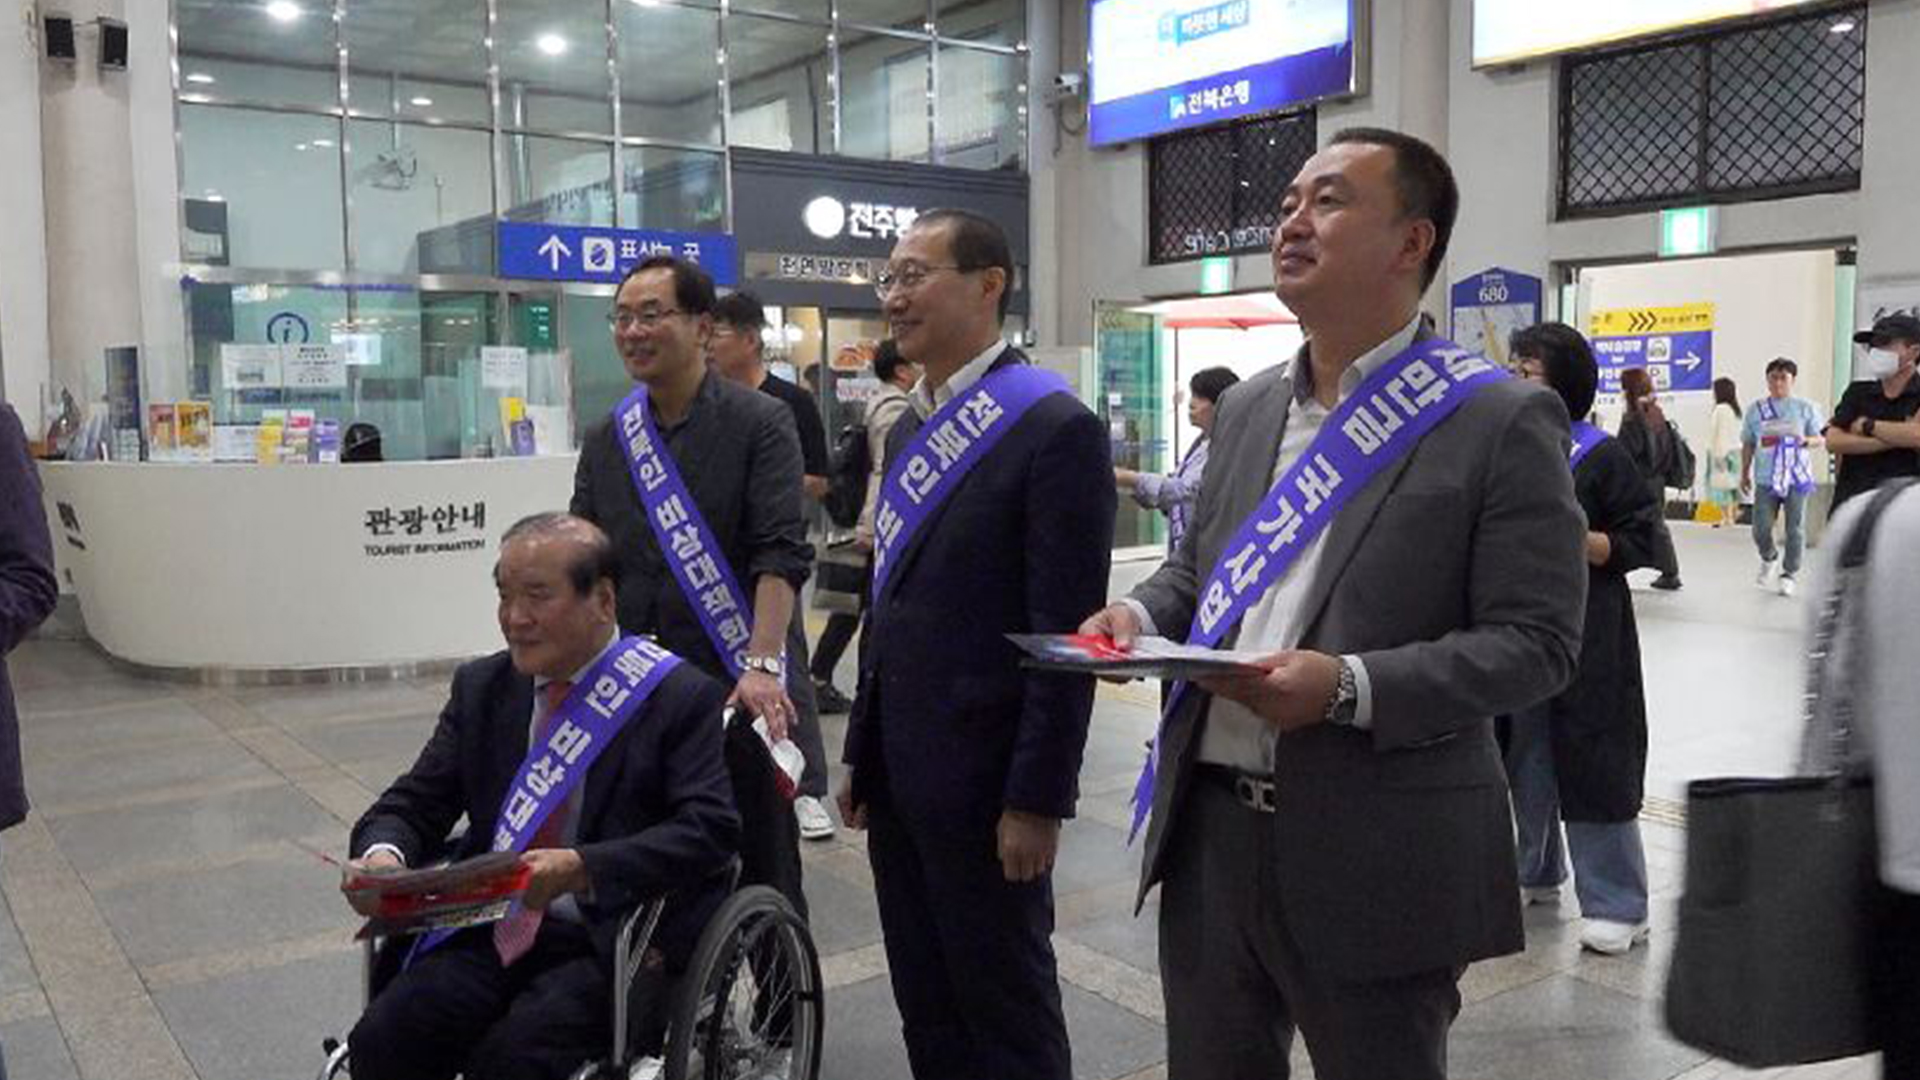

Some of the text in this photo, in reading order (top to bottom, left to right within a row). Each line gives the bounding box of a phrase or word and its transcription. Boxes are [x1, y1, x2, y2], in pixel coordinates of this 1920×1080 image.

[1188, 79, 1249, 115] 전북은행
[1479, 285, 1509, 303] 680
[622, 402, 668, 492] 전북인
[898, 389, 1004, 505] 전북인
[365, 501, 485, 536] 관광안내
[364, 539, 485, 556] TOURIST INFORMATION
[1199, 452, 1344, 635] 국가사업
